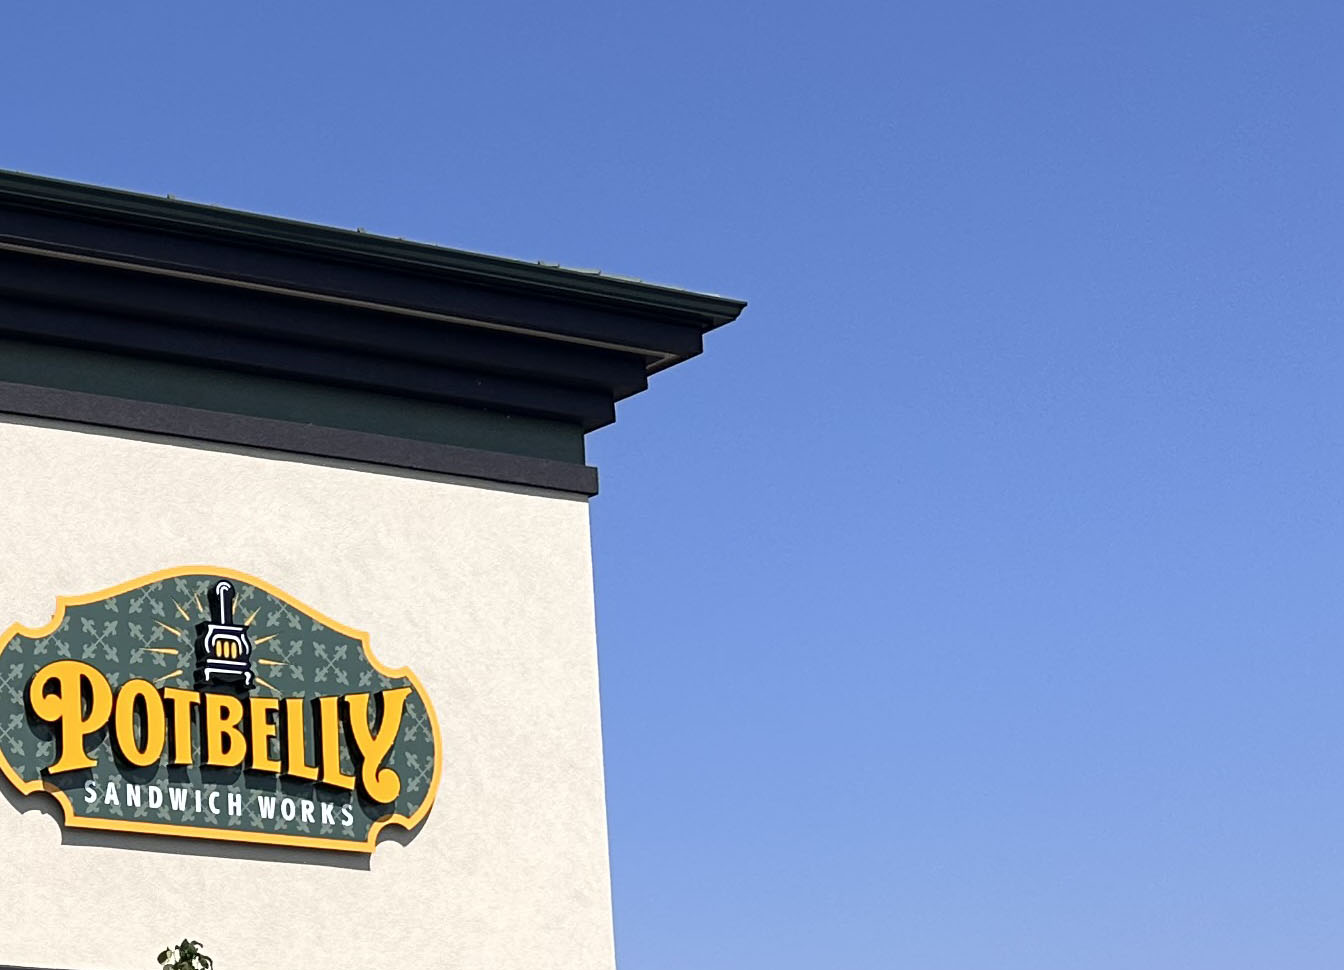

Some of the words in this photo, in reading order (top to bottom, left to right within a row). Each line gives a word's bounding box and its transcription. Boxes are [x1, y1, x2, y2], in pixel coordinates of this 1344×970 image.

[29, 660, 412, 804] POTBELLY
[84, 780, 243, 817] SANDWICH
[258, 796, 355, 828] WORKS
